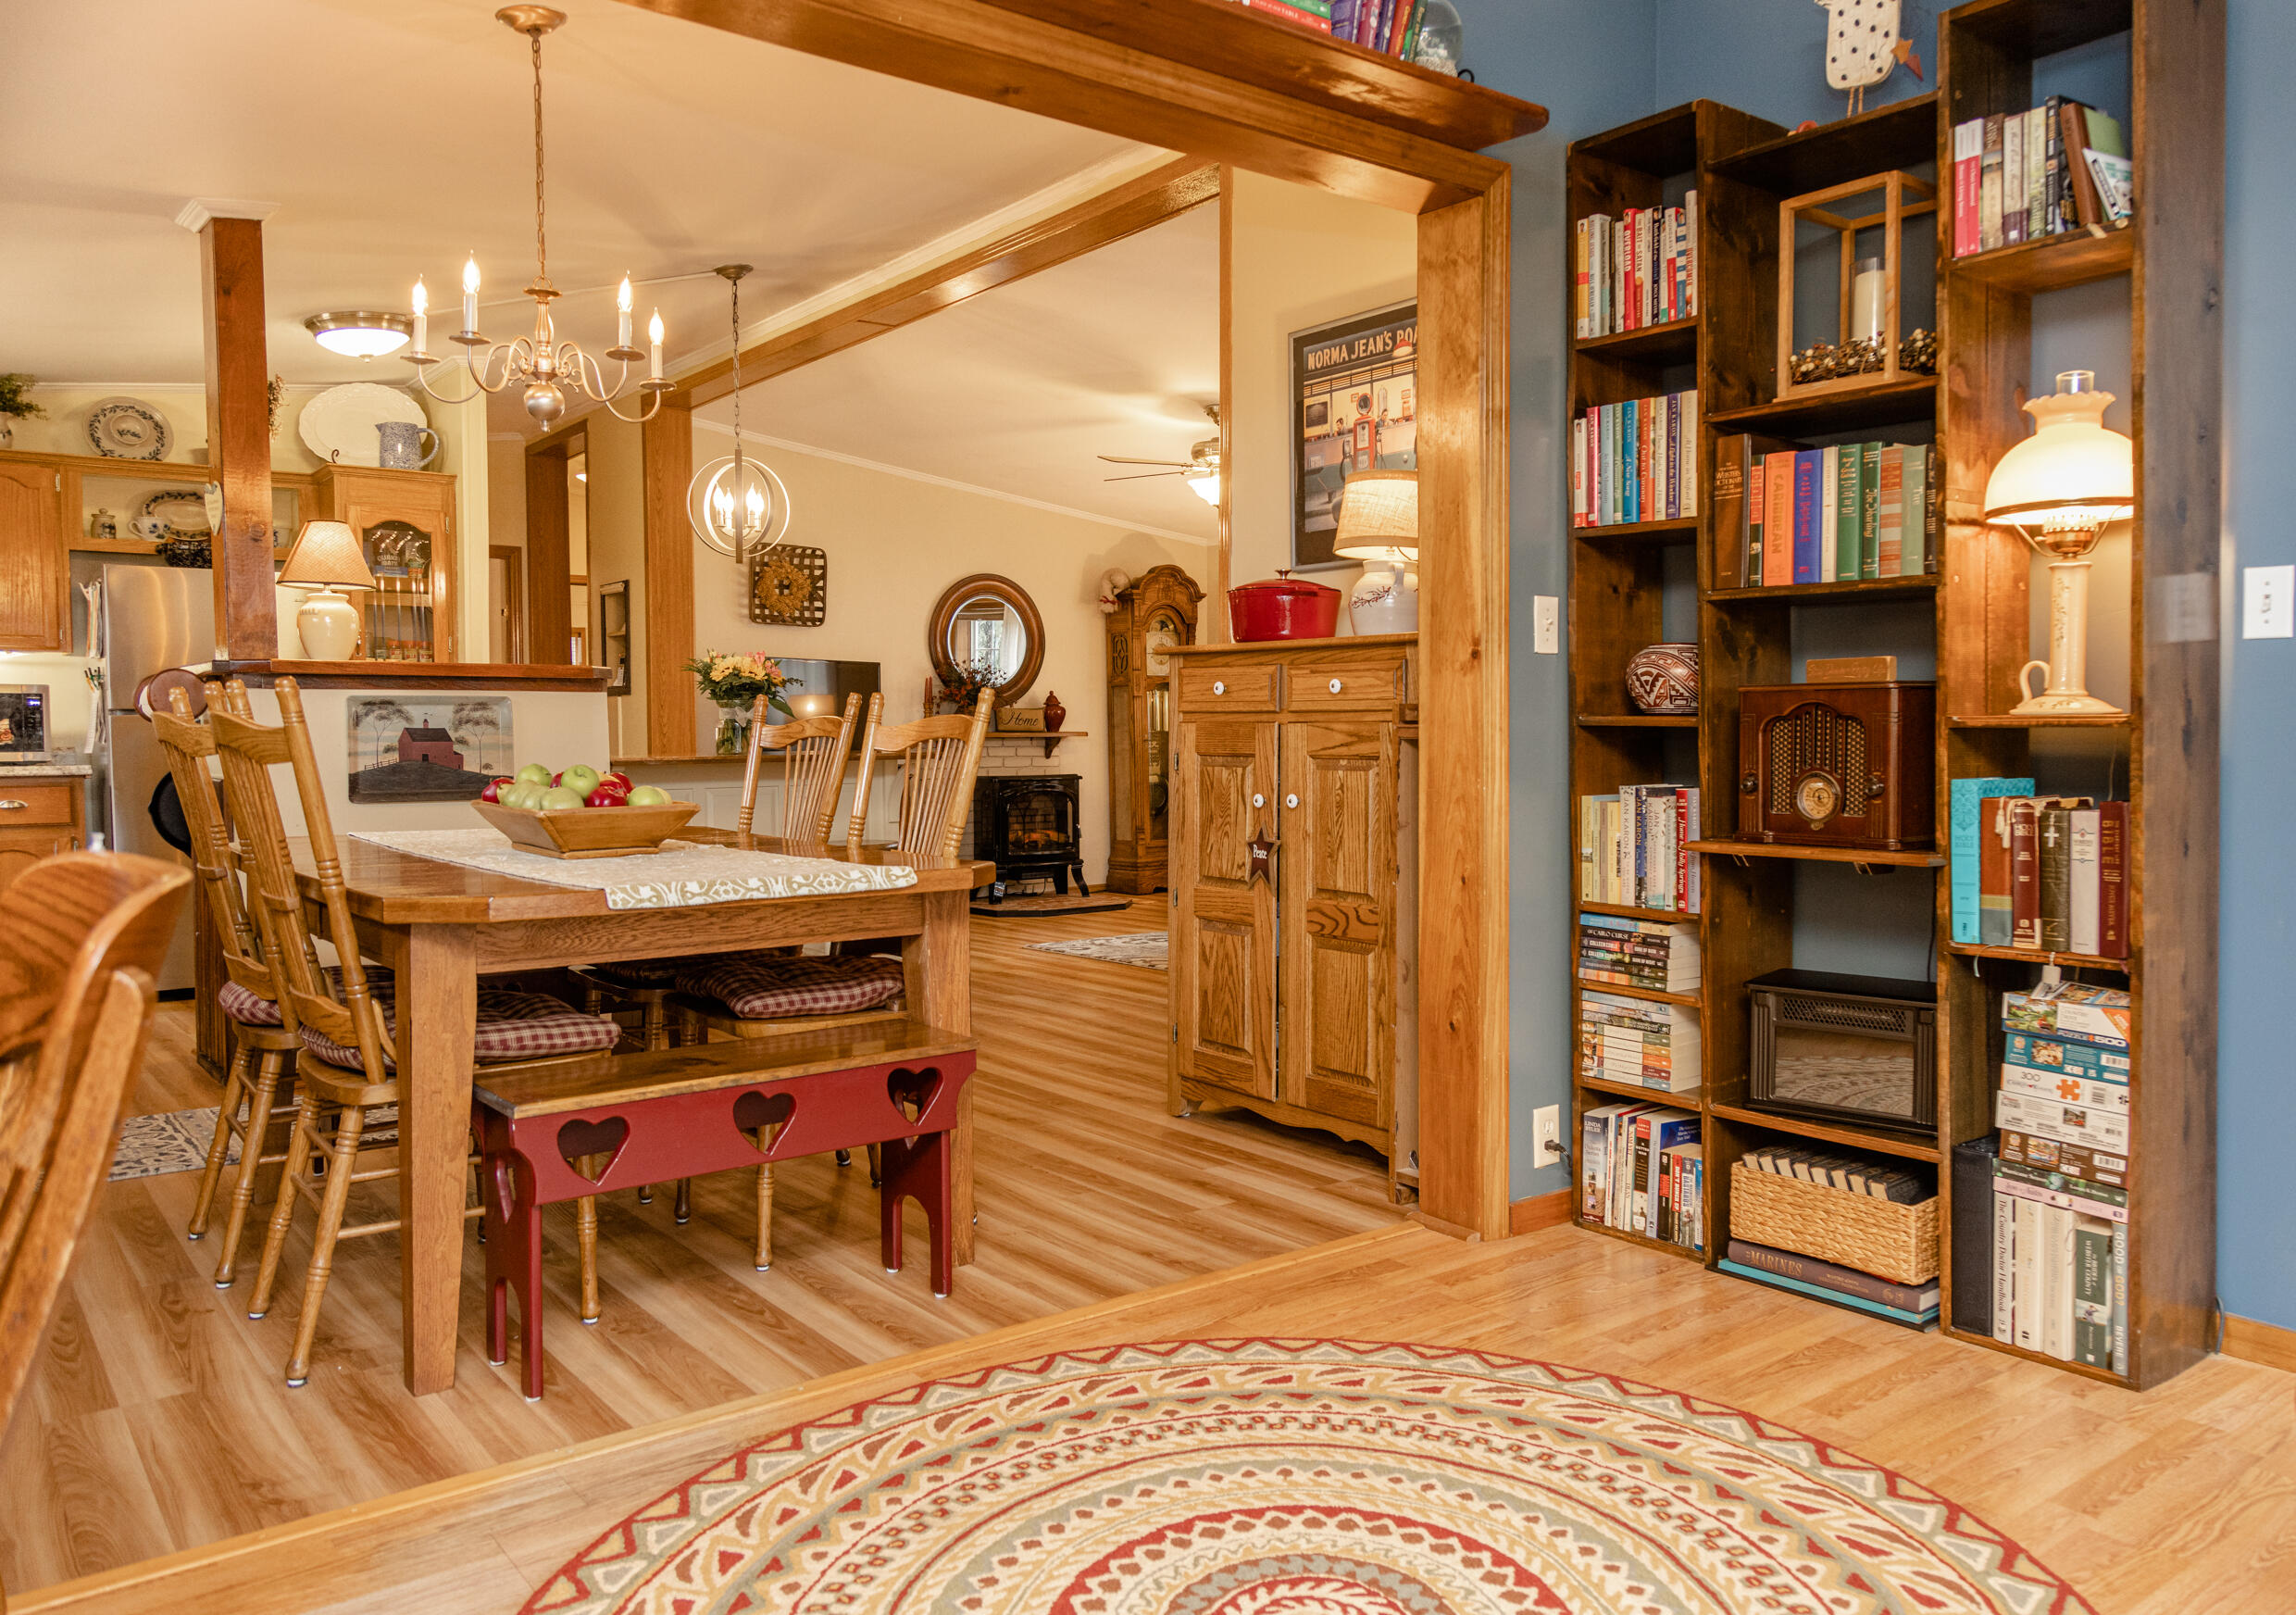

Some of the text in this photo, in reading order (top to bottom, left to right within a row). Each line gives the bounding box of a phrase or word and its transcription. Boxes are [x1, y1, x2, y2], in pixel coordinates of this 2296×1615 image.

[1306, 344, 1349, 371] NORMA
[1351, 330, 1393, 360] JEAN'S
[1770, 473, 1784, 555] CARIBBEAN
[1003, 711, 1038, 727] Home
[1678, 816, 1687, 840] Home
[1253, 844, 1267, 859] Peace
[2102, 820, 2115, 864] BIBLE
[1611, 930, 1629, 940] CURSE
[2094, 1033, 2127, 1047] 500
[2021, 1071, 2041, 1082] 300
[1584, 1120, 1601, 1129] LINDA
[1998, 1214, 2006, 1244] Country
[1998, 1246, 2006, 1270] Doctor
[2115, 1232, 2125, 1264] GOOD
[1749, 1250, 1803, 1277] MARINES
[1998, 1272, 2006, 1313] Handbook
[2115, 1274, 2125, 1306] GOD?
[2115, 1325, 2125, 1358] BEVERE
